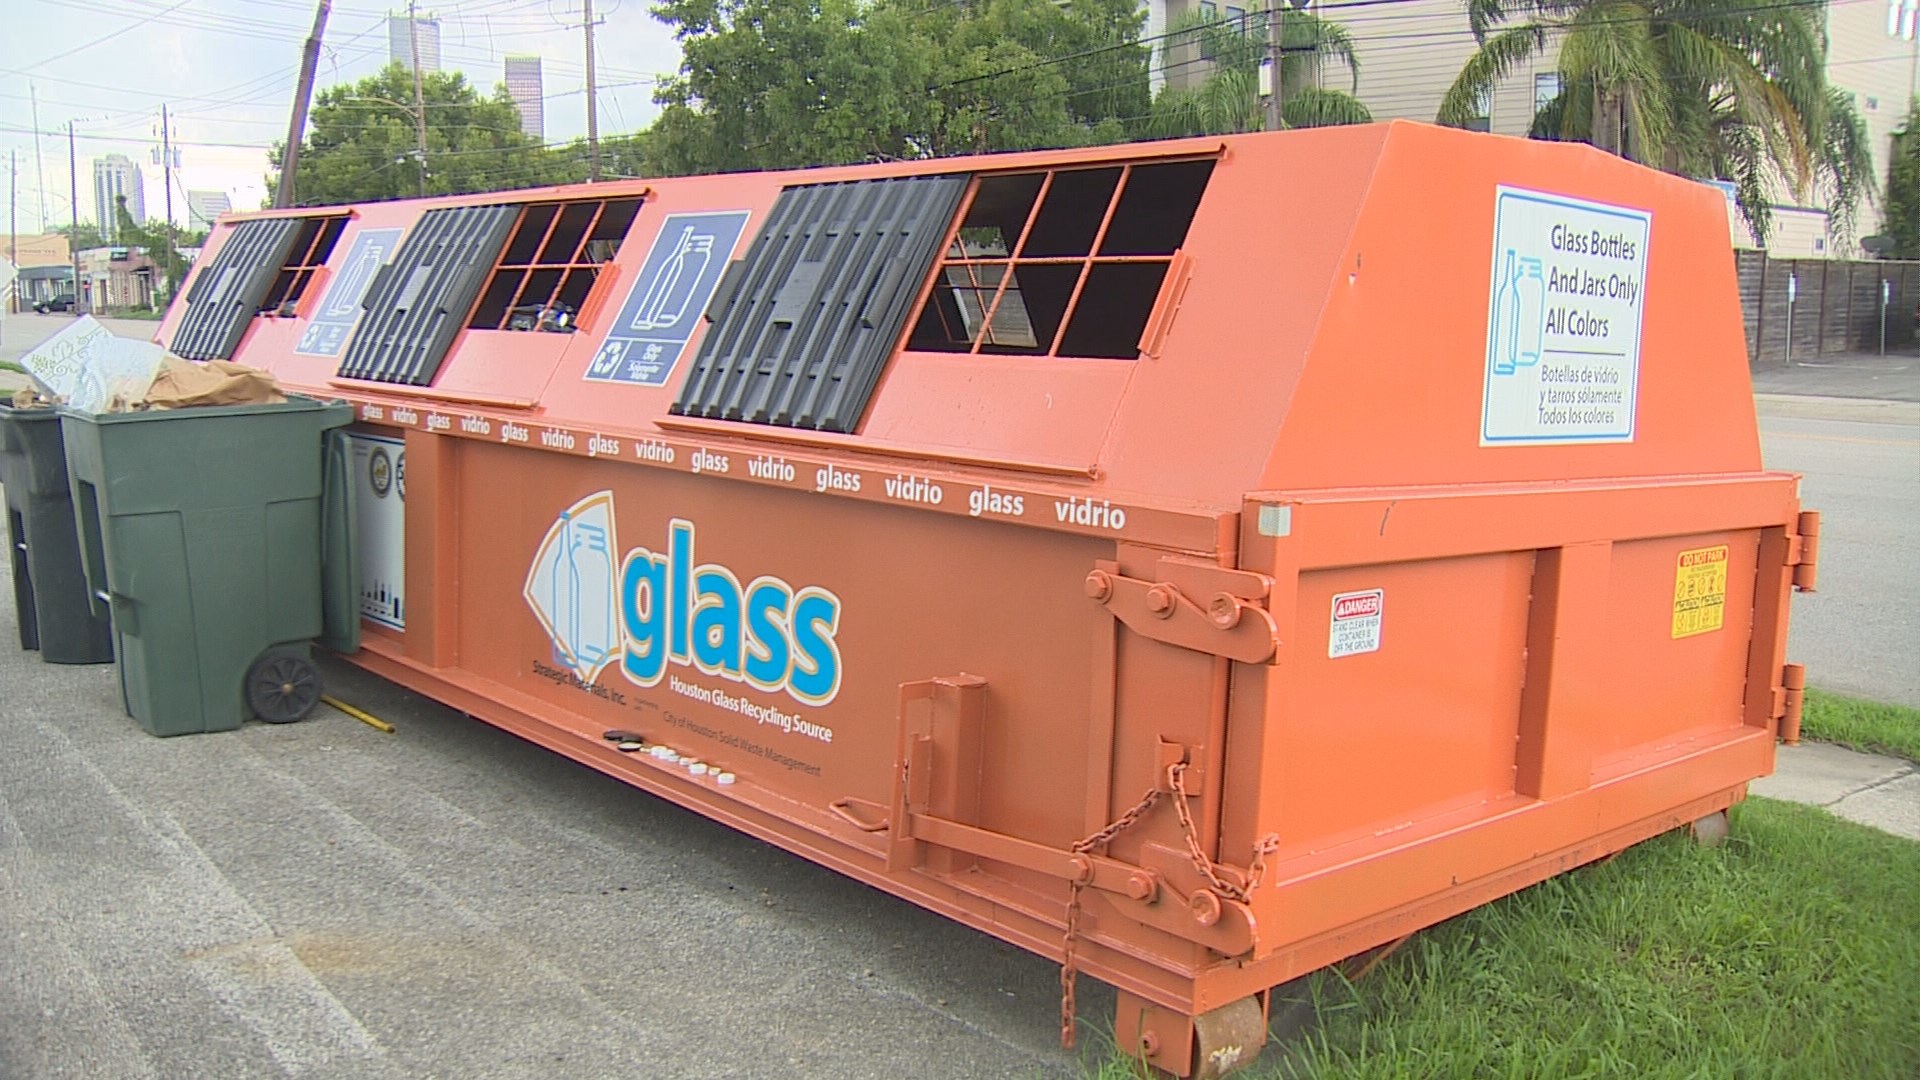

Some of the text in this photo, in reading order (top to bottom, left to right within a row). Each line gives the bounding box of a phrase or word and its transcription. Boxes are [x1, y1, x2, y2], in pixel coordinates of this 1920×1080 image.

[1551, 224, 1636, 260] Glass Bottles
[1548, 266, 1638, 307] And Jars Only
[1545, 307, 1609, 338] All Colors
[1541, 365, 1619, 384] Botellas de vidrio
[1539, 390, 1546, 408] y
[1548, 387, 1575, 403] tarros
[1539, 406, 1614, 424] Todos los colores
[362, 402, 1126, 530] glass vidrio glass vidrio glass vidrio glass vidrio glass vidrio glass vidrio glass vidrio
[1683, 554, 1694, 566] DO
[1695, 552, 1707, 564] NOT
[620, 518, 842, 707] glass
[1345, 599, 1377, 615] DANGER
[533, 660, 568, 685] Strategic
[611, 687, 627, 706] Inc.
[670, 674, 833, 743] Houston Glass Recycling Source
[663, 711, 821, 777] City of Houston Solid Waste Management
